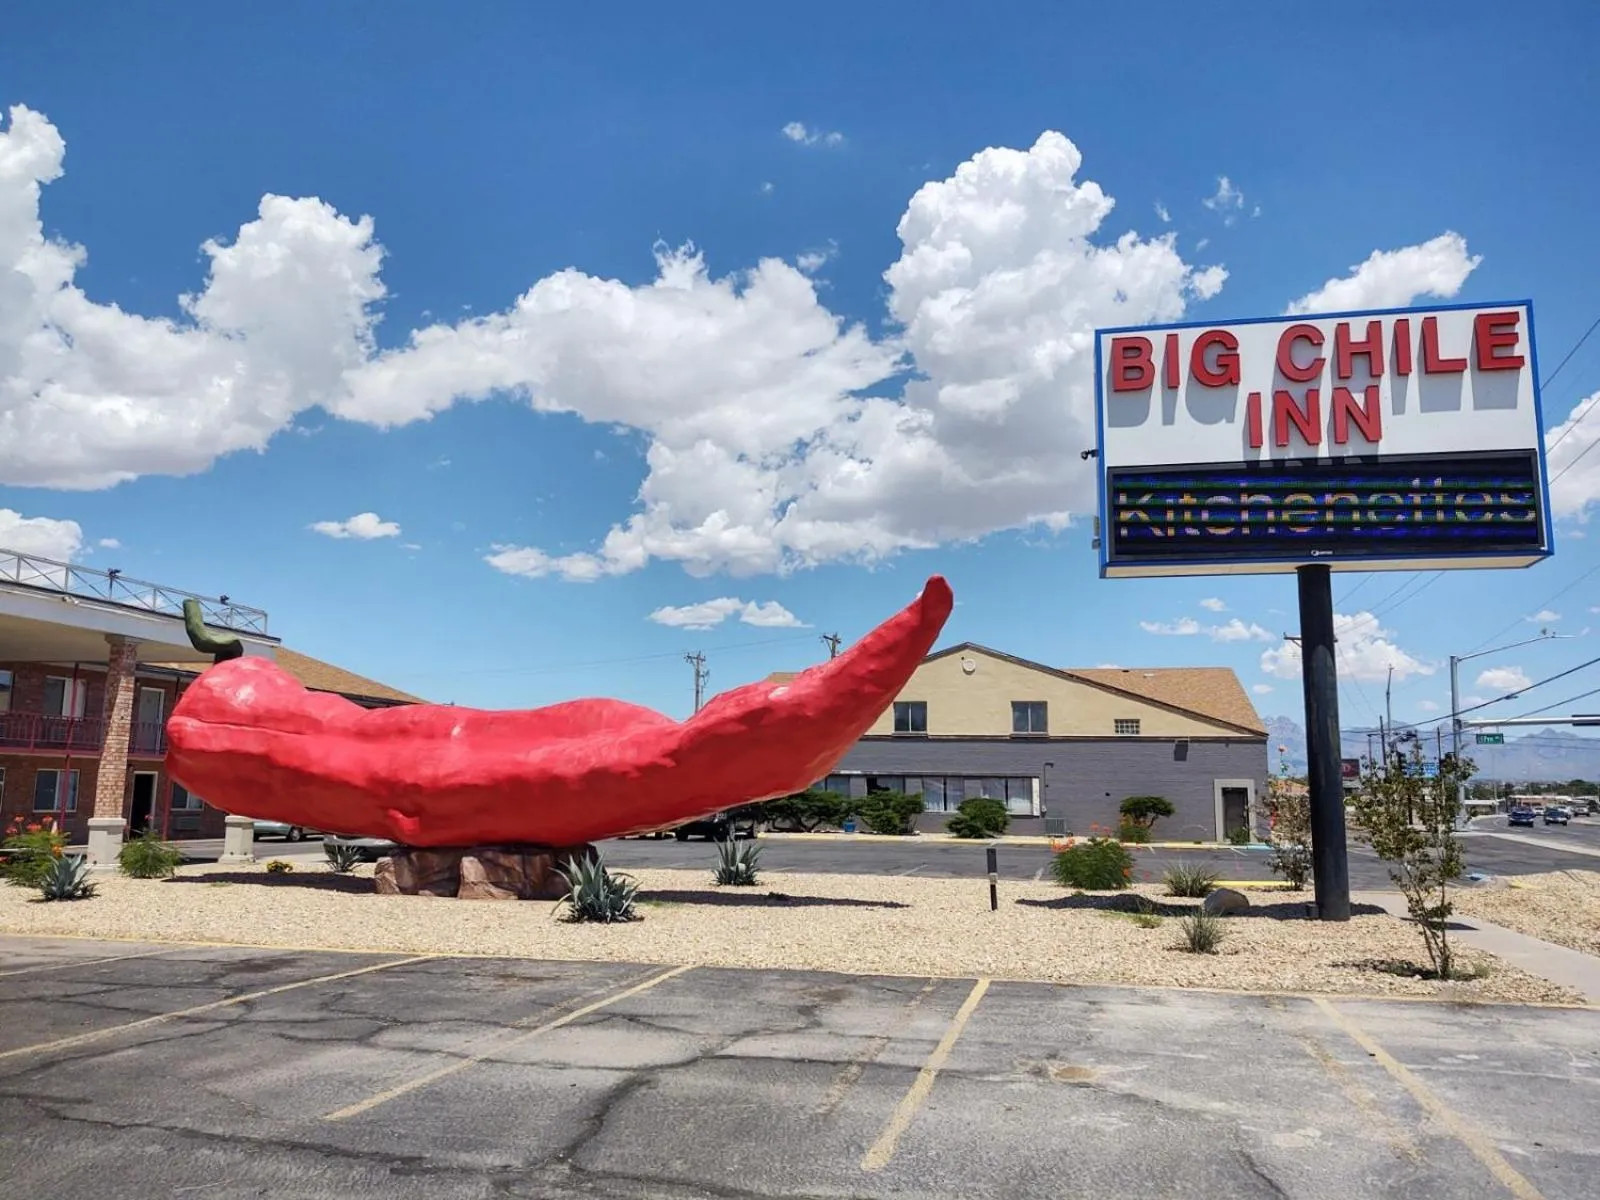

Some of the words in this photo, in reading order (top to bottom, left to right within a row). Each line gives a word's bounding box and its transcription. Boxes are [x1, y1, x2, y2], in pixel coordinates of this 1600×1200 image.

[1111, 329, 1241, 392] BIG
[1276, 311, 1525, 383] CHILE
[1248, 385, 1383, 448] INN
